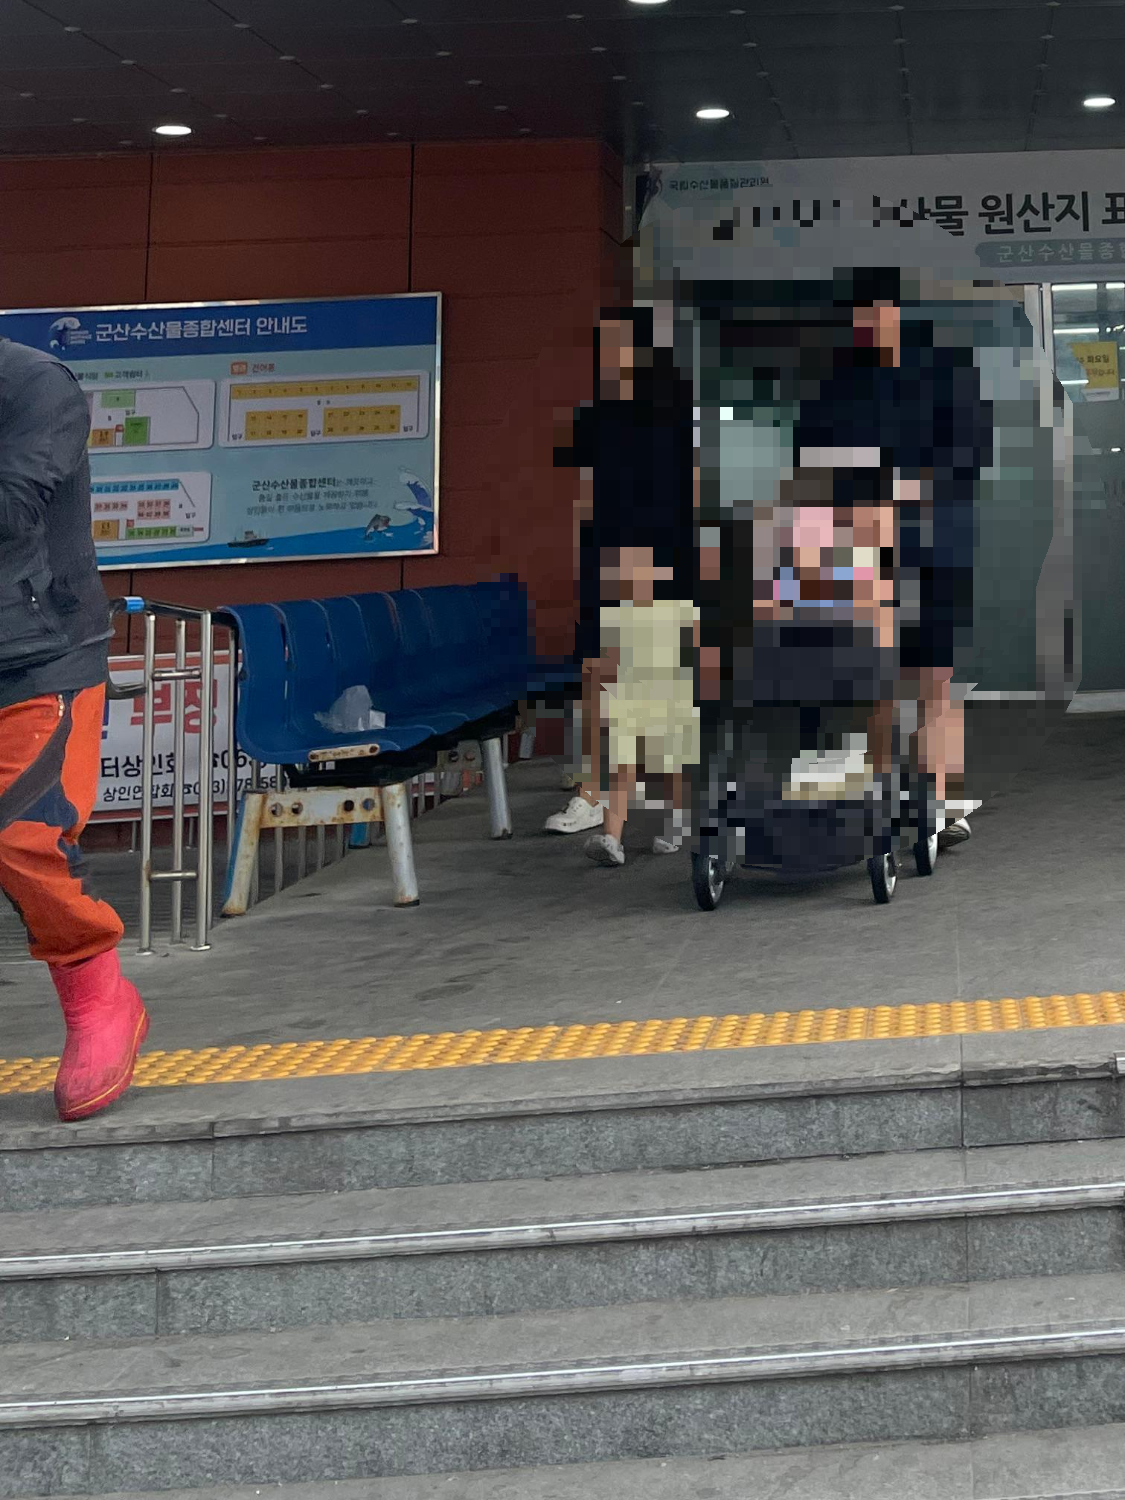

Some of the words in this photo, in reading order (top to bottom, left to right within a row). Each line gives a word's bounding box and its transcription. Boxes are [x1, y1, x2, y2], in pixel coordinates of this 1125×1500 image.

[978, 191, 1090, 234] 원산지
[96, 318, 250, 342] 군산수산물종합센터
[257, 316, 308, 335] 안내도
